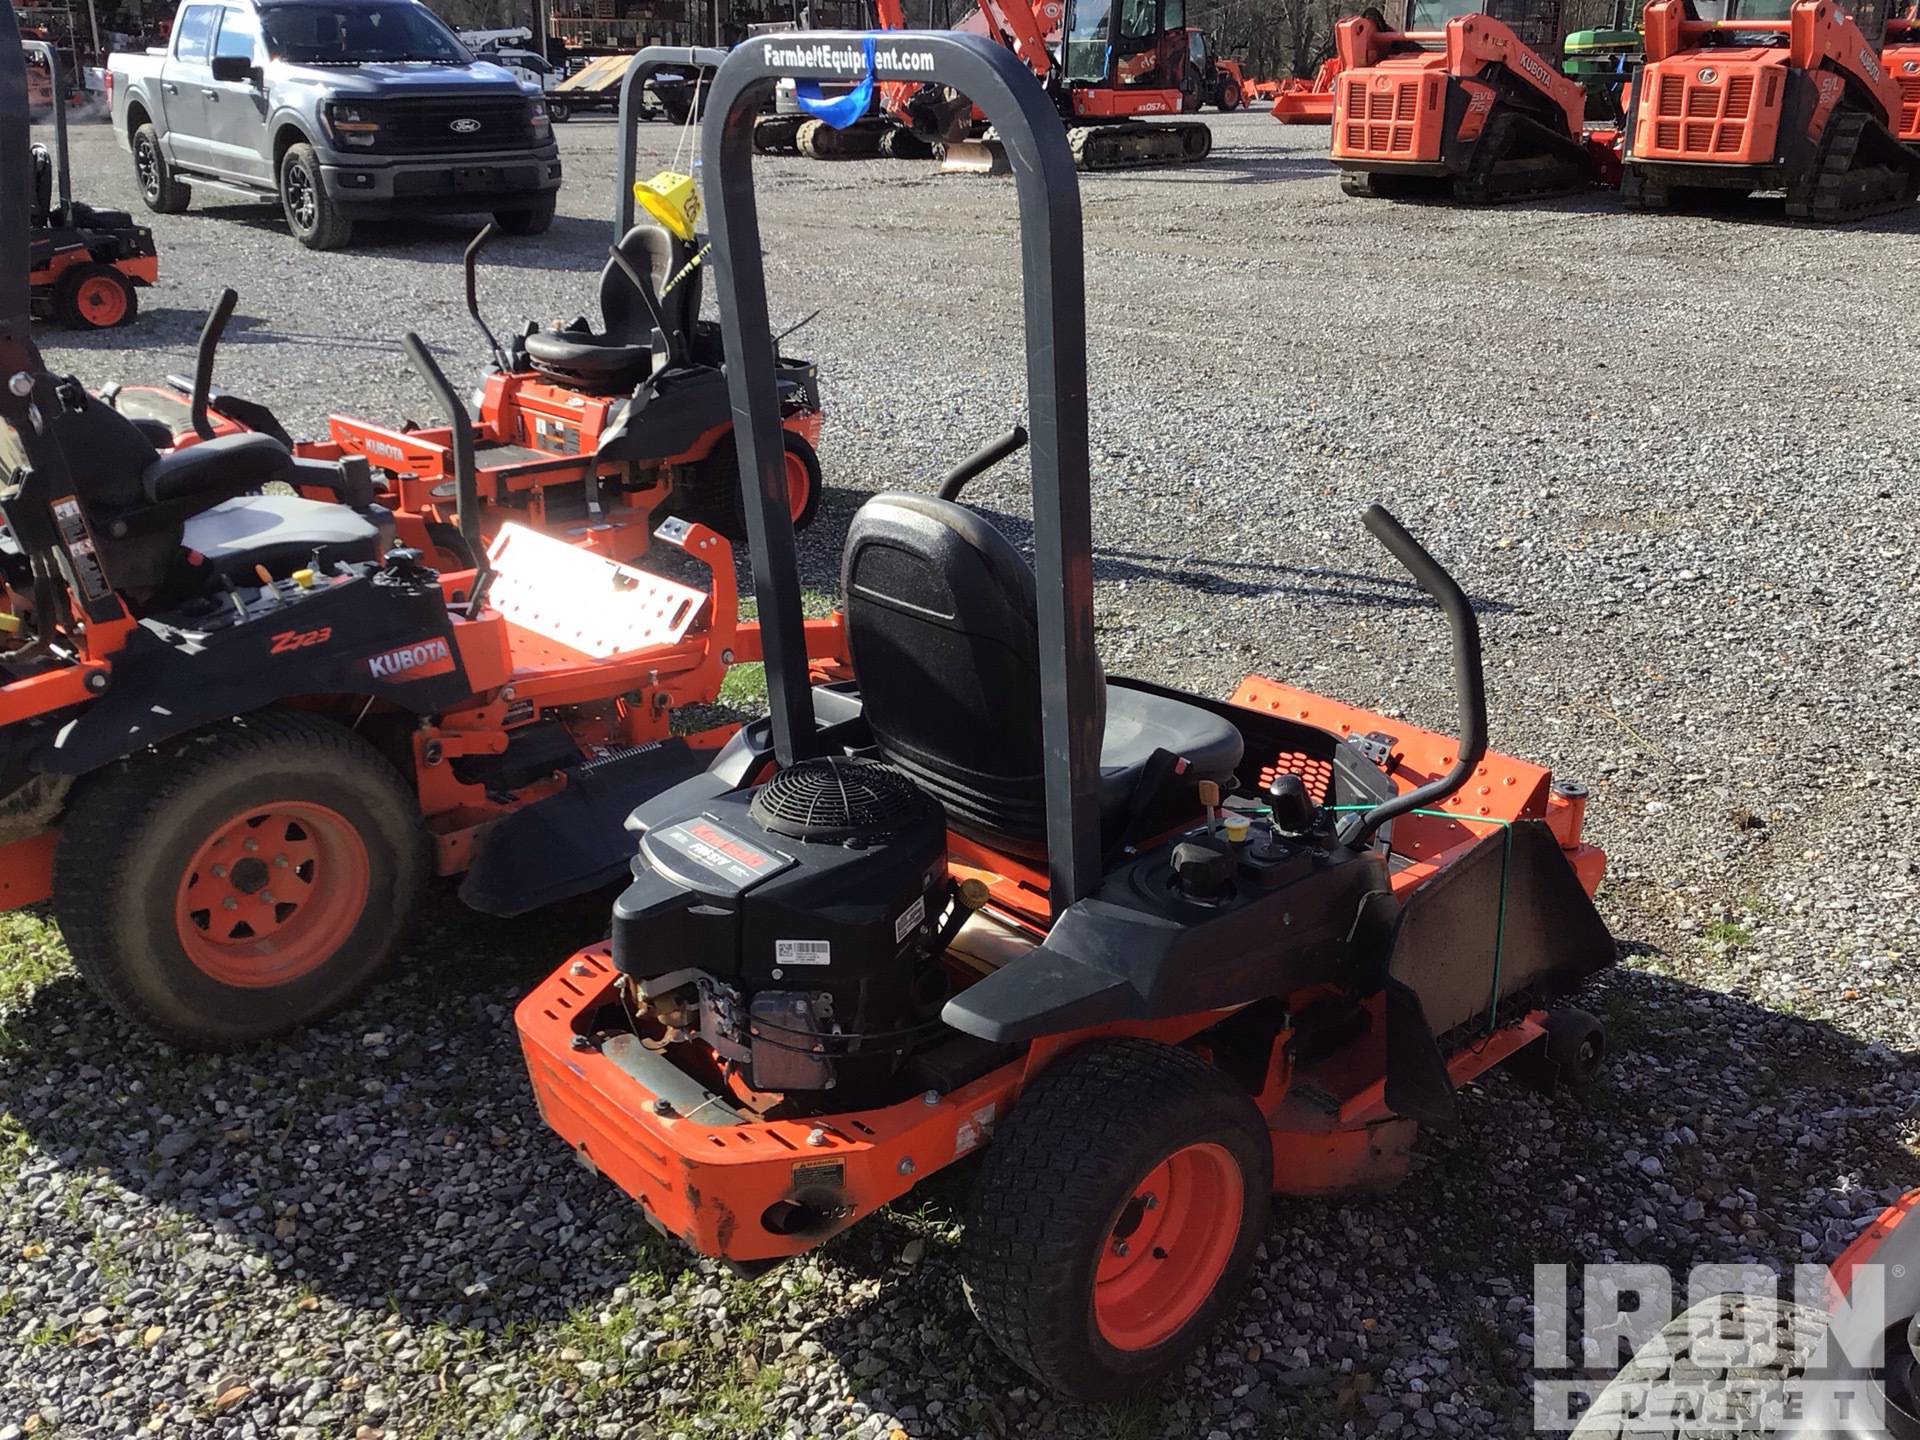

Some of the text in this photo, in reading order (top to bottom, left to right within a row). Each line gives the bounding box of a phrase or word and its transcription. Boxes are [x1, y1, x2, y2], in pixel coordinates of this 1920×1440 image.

[1519, 53, 1551, 87] KUBOTA
[1859, 47, 1880, 84] KUBOTA
[365, 437, 405, 462] KUBOTA
[270, 626, 332, 655] Z723
[368, 640, 448, 678] KUBOTA
[688, 822, 768, 868] Kawasaki
